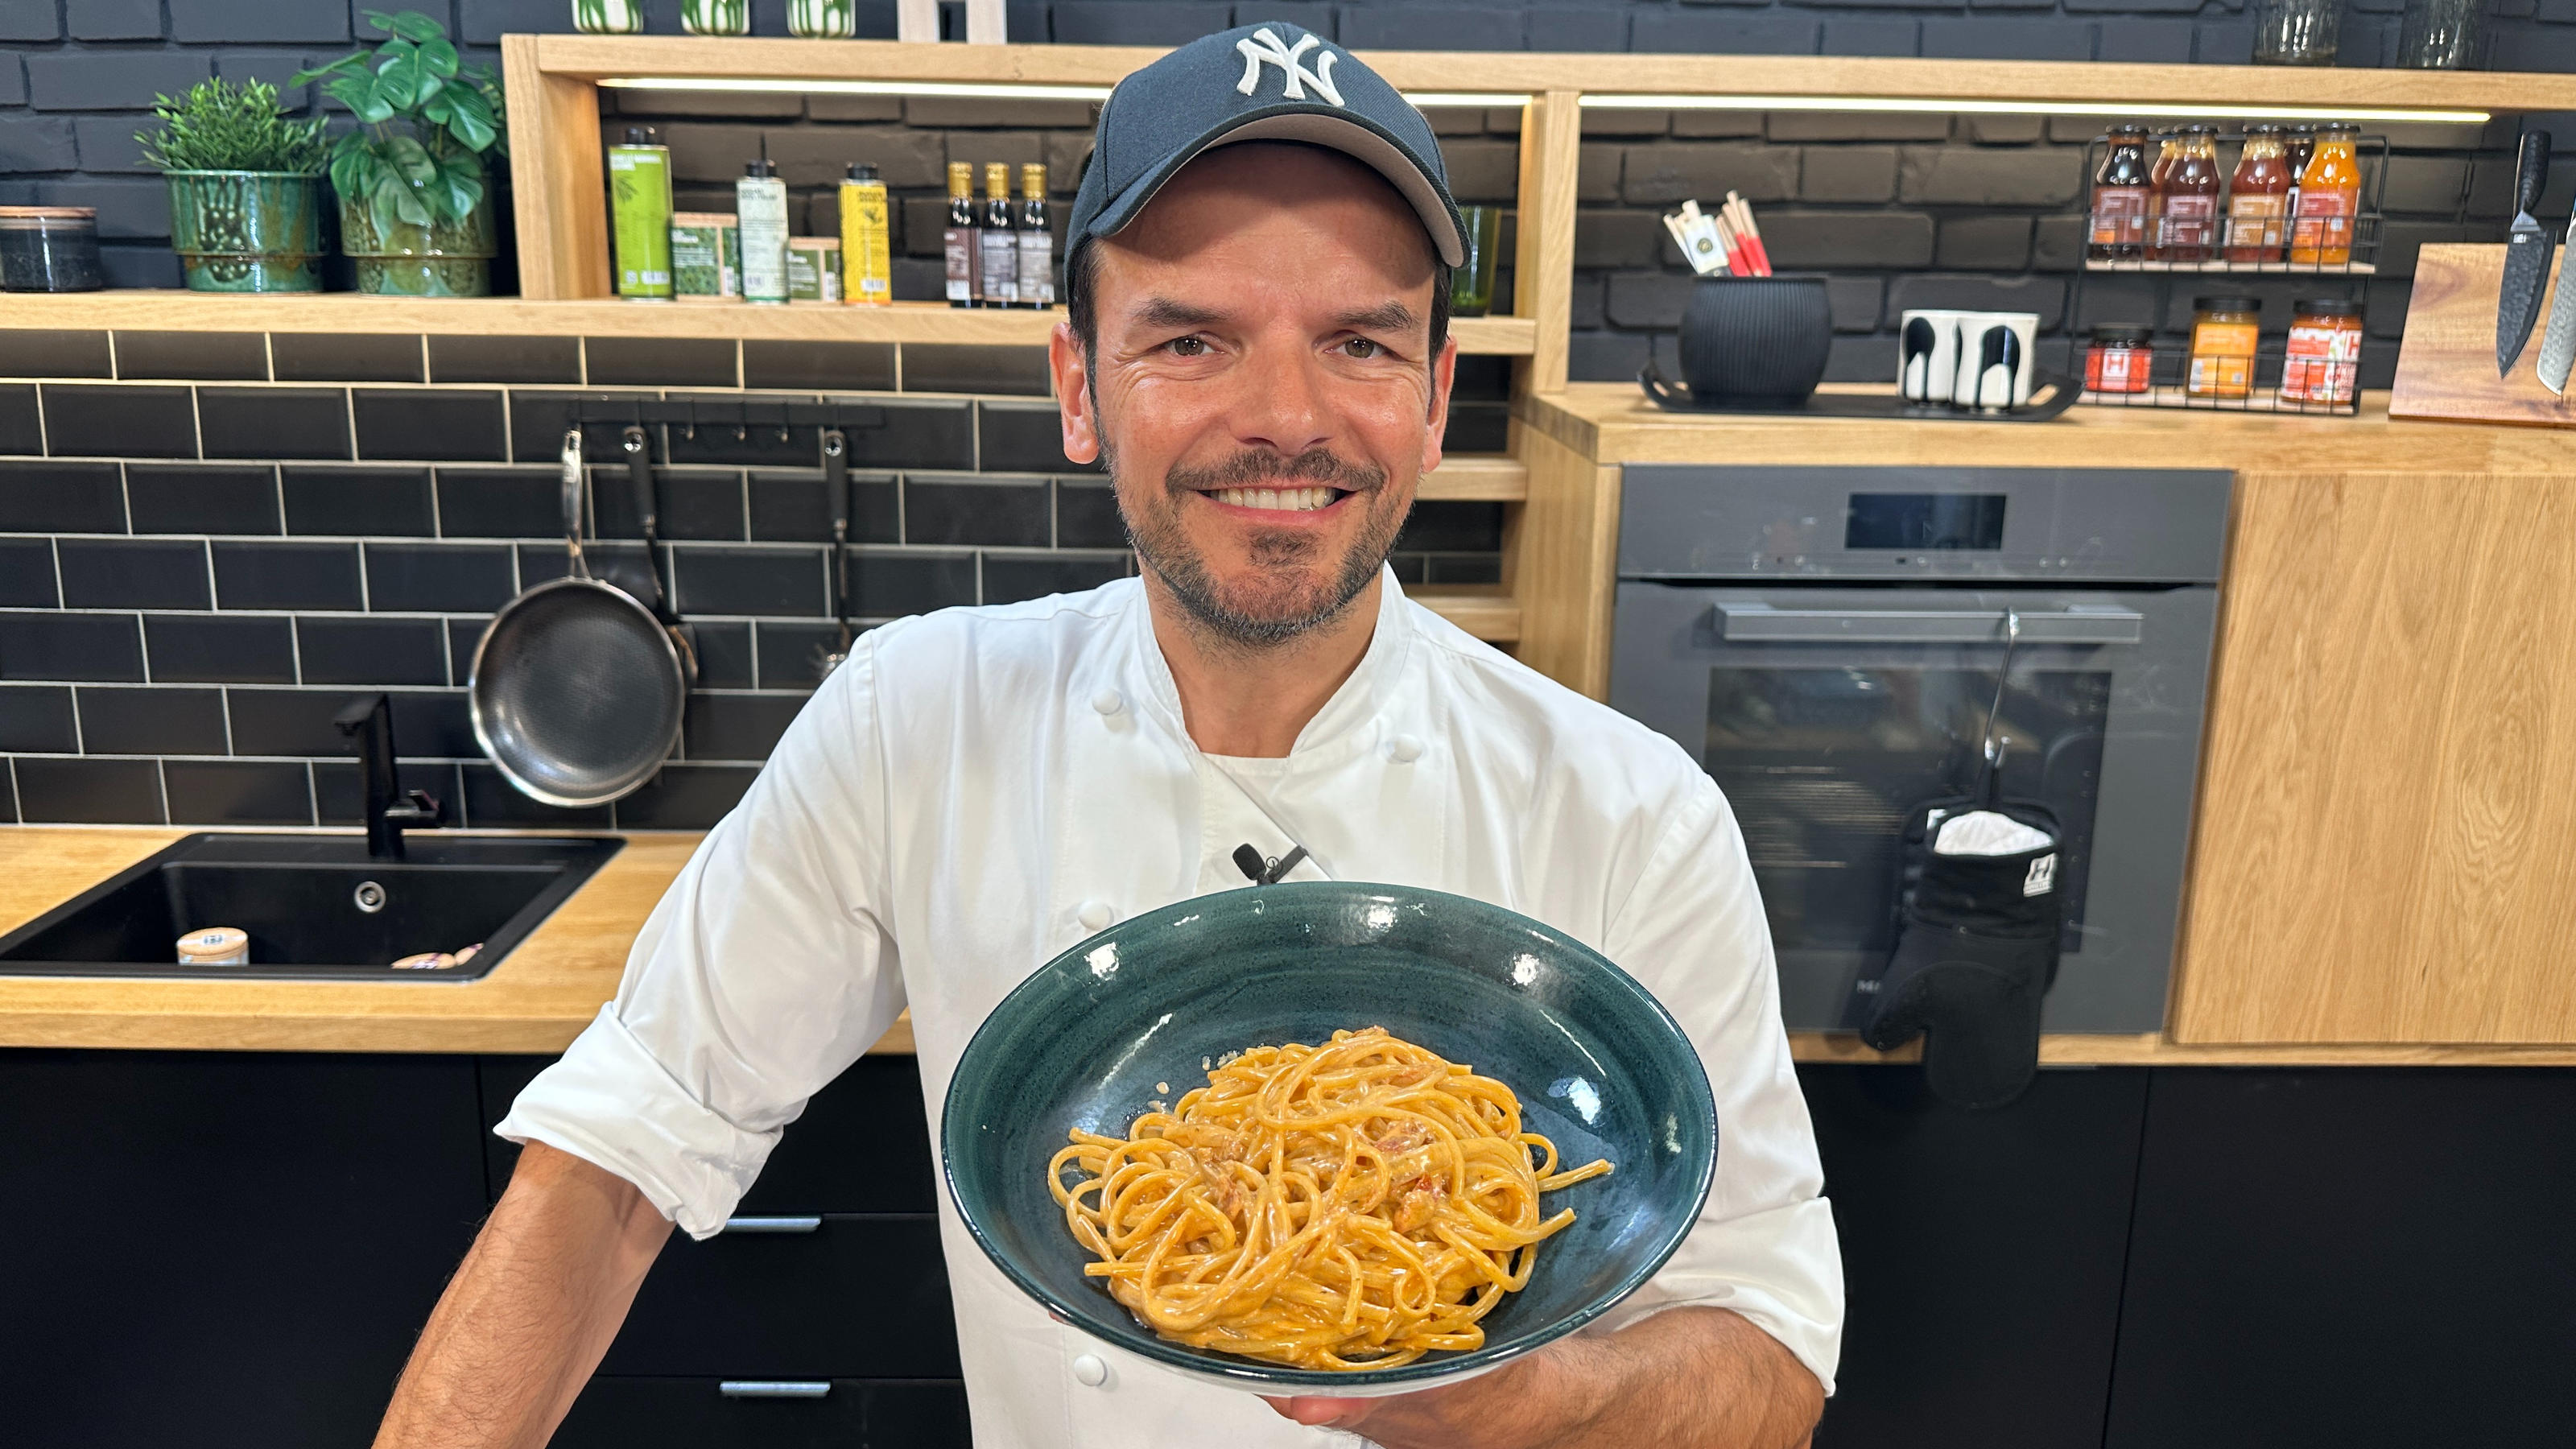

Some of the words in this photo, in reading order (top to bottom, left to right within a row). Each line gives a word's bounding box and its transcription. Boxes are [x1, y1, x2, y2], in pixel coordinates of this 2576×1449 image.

[1236, 27, 1345, 107] NY
[2107, 353, 2124, 374] H
[2029, 858, 2051, 881] H
